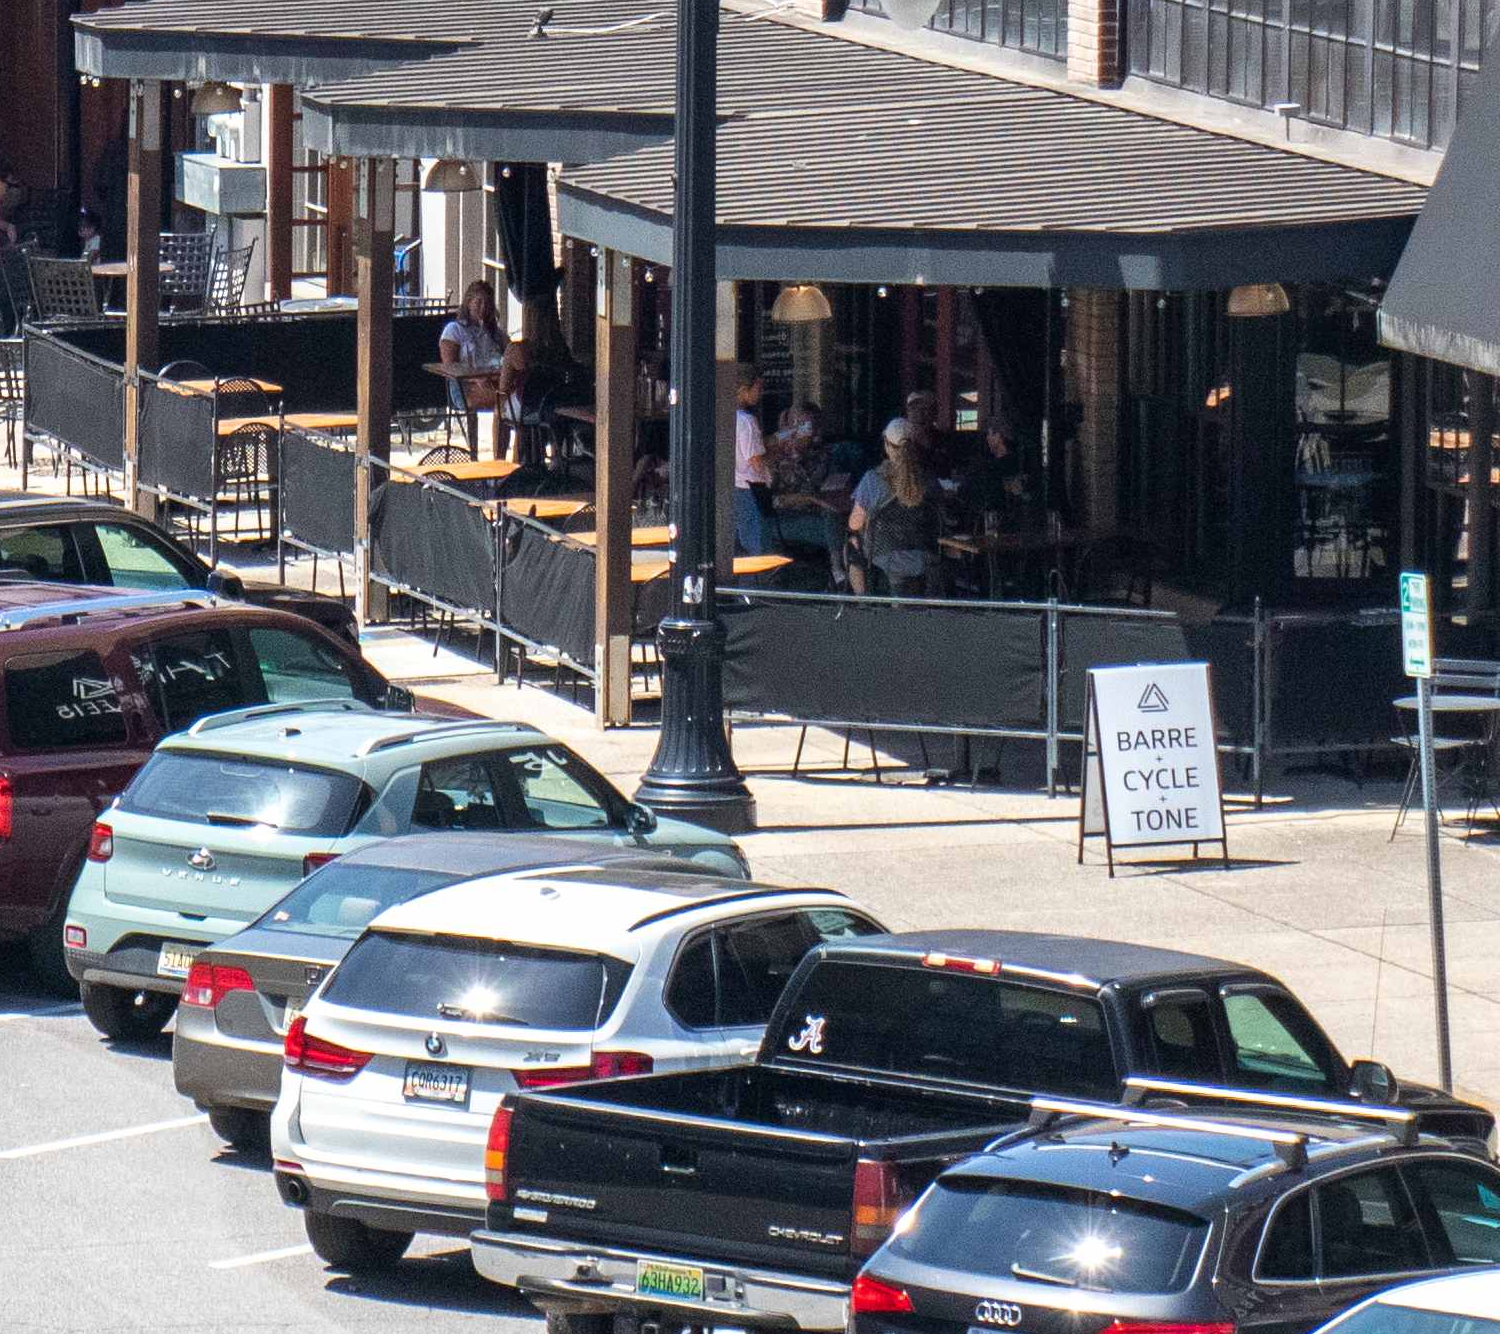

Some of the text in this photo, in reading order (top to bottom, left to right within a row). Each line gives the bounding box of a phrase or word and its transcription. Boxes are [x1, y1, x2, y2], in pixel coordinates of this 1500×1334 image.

[1116, 727, 1198, 752] BARRE
[1123, 767, 1200, 791] CYCLE
[1131, 807, 1199, 831] TONE
[767, 1225, 845, 1245] CHEVROLET
